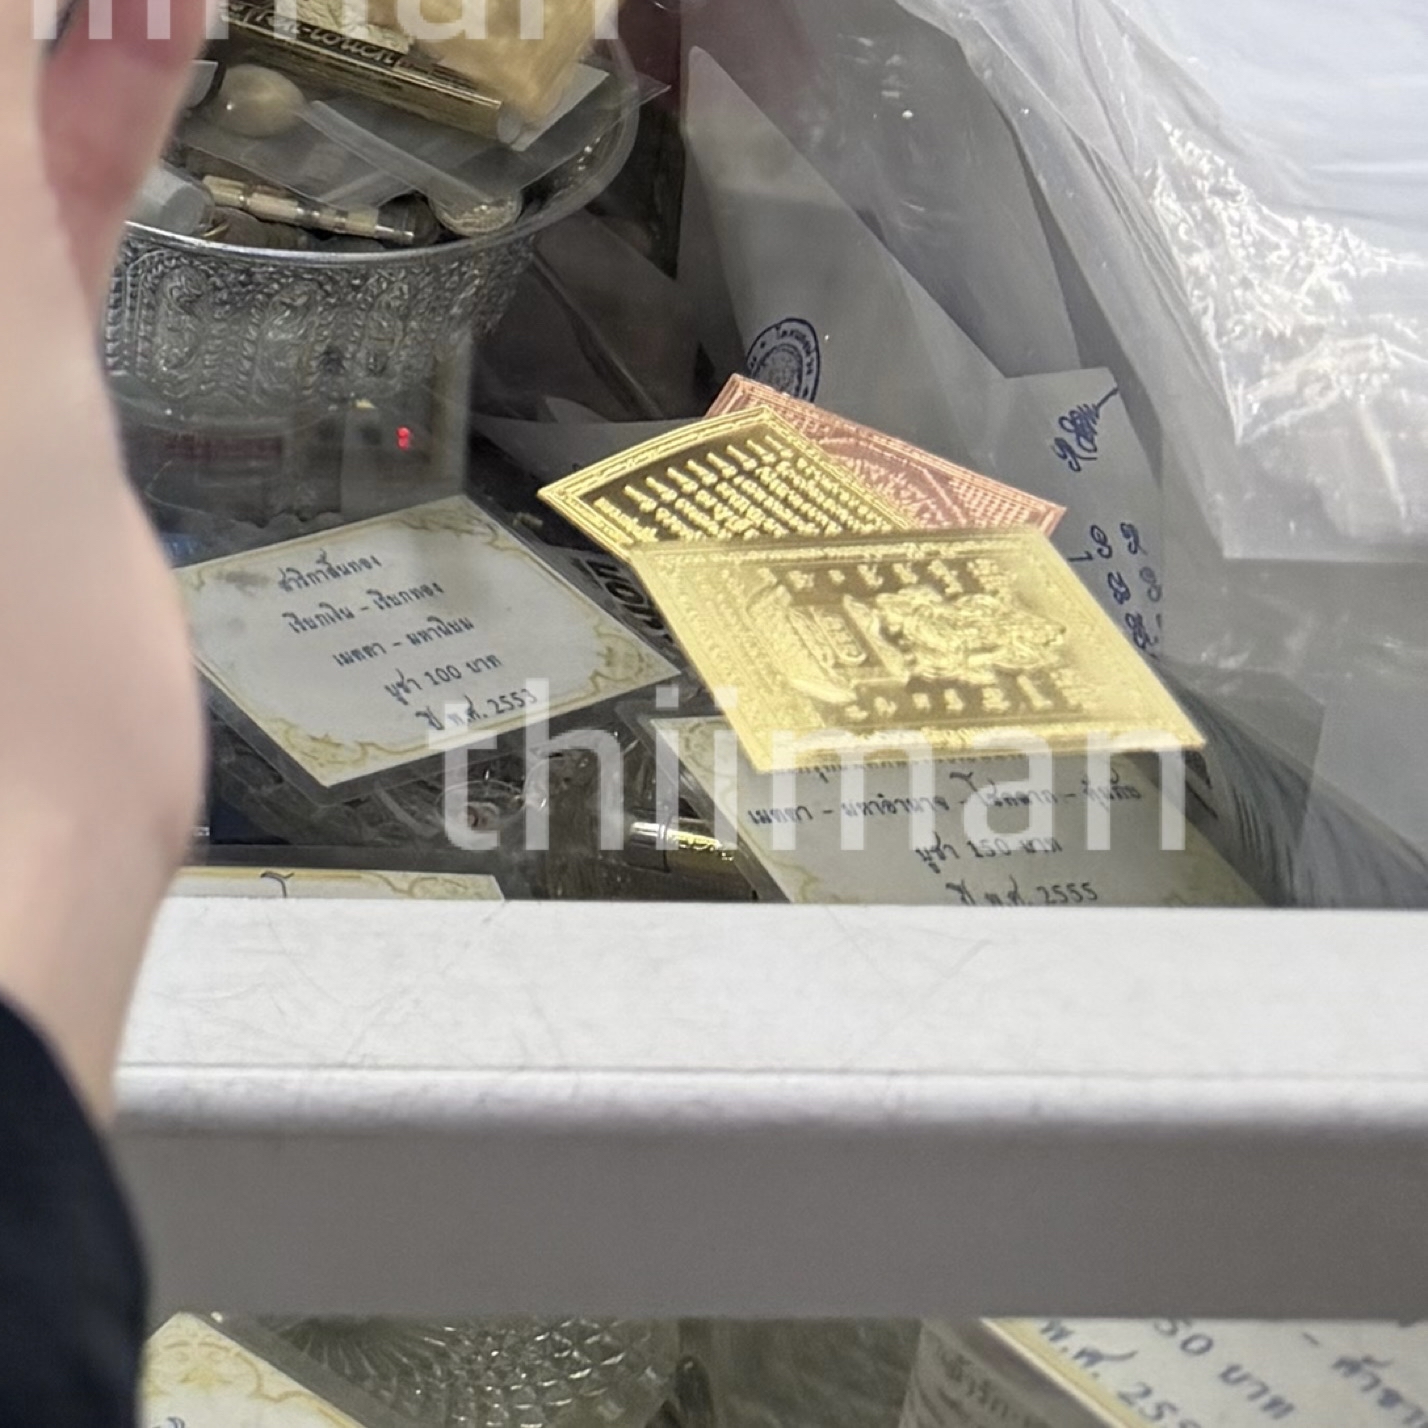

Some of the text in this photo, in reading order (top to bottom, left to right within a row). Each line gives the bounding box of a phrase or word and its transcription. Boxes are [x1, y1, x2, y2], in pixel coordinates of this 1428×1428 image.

[384, 653, 504, 706] บูชา 100 บาท
